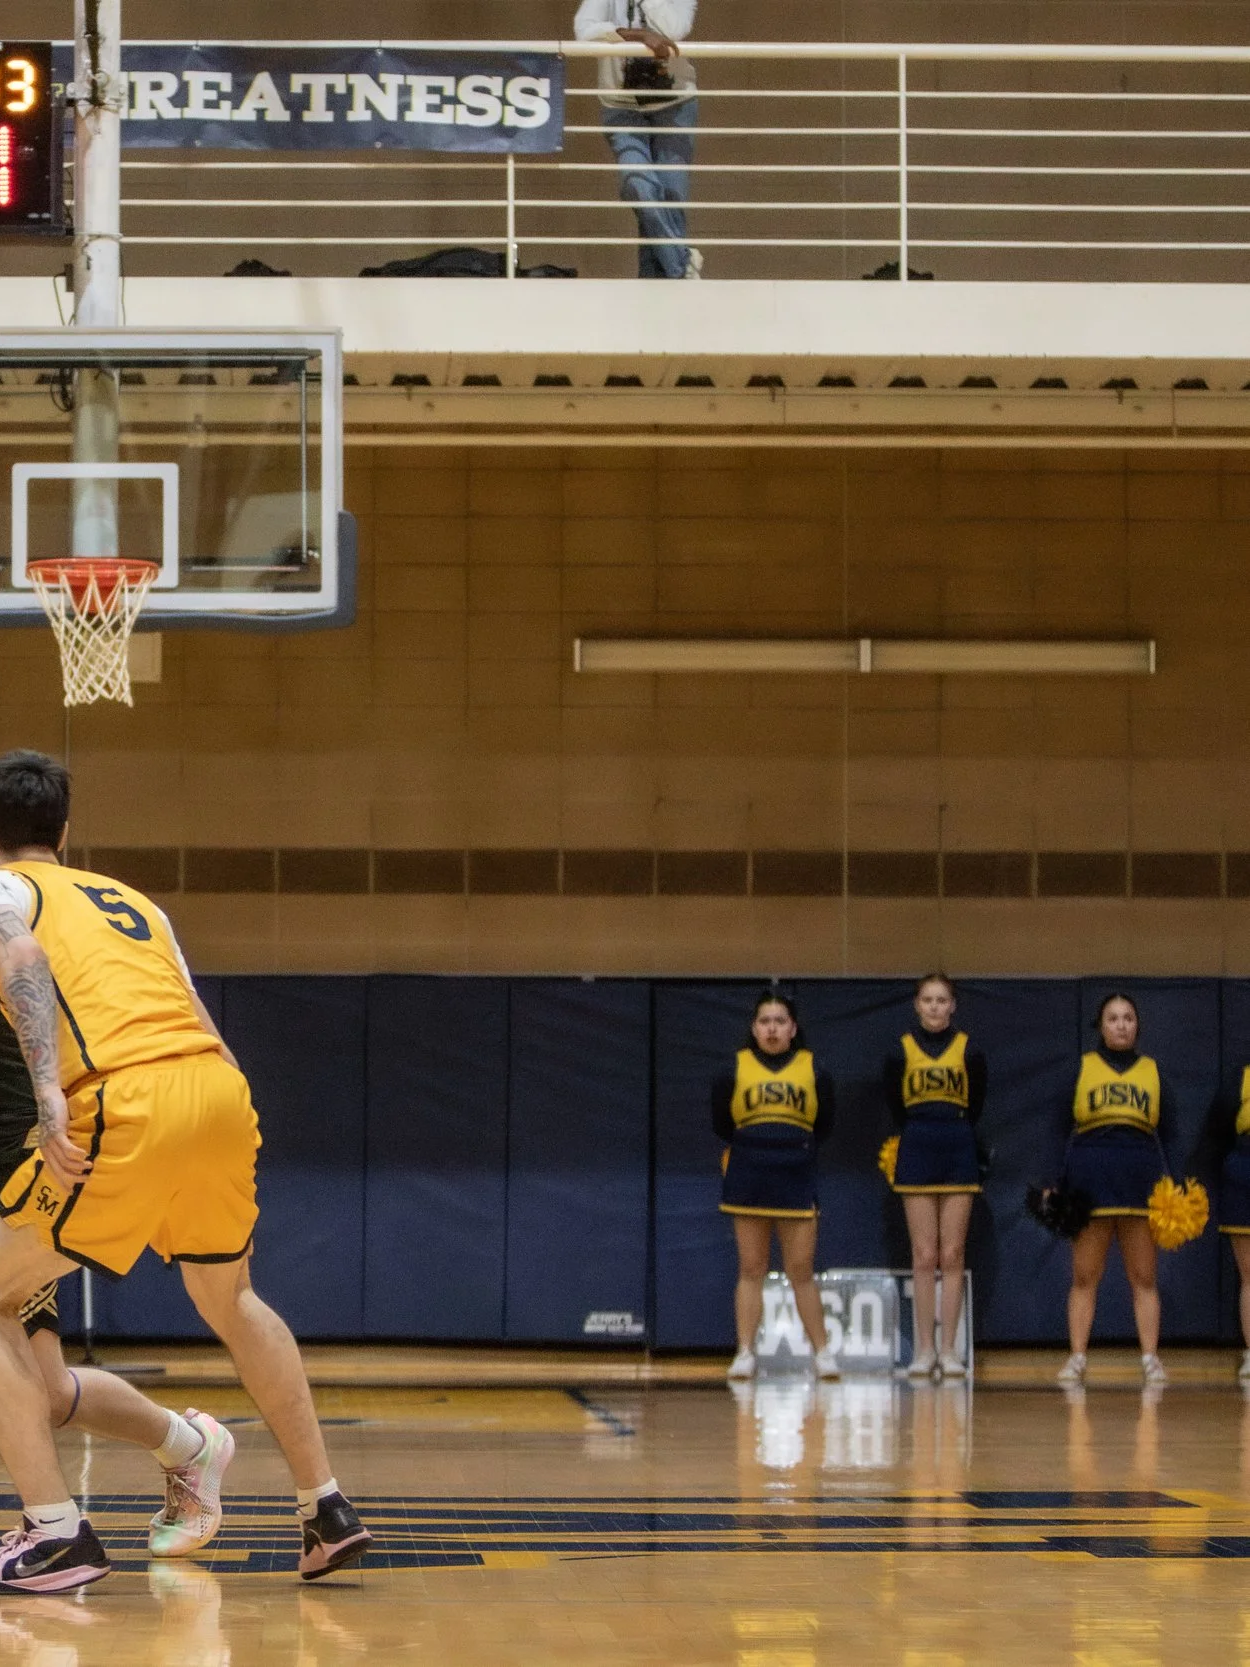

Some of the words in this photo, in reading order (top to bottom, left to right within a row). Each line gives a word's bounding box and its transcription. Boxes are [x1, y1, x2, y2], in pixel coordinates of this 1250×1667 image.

[119, 71, 551, 128] REATNESS
[73, 883, 152, 941] 5
[744, 1081, 807, 1112] USM
[907, 1067, 964, 1097] USM
[1088, 1082, 1150, 1117] USM
